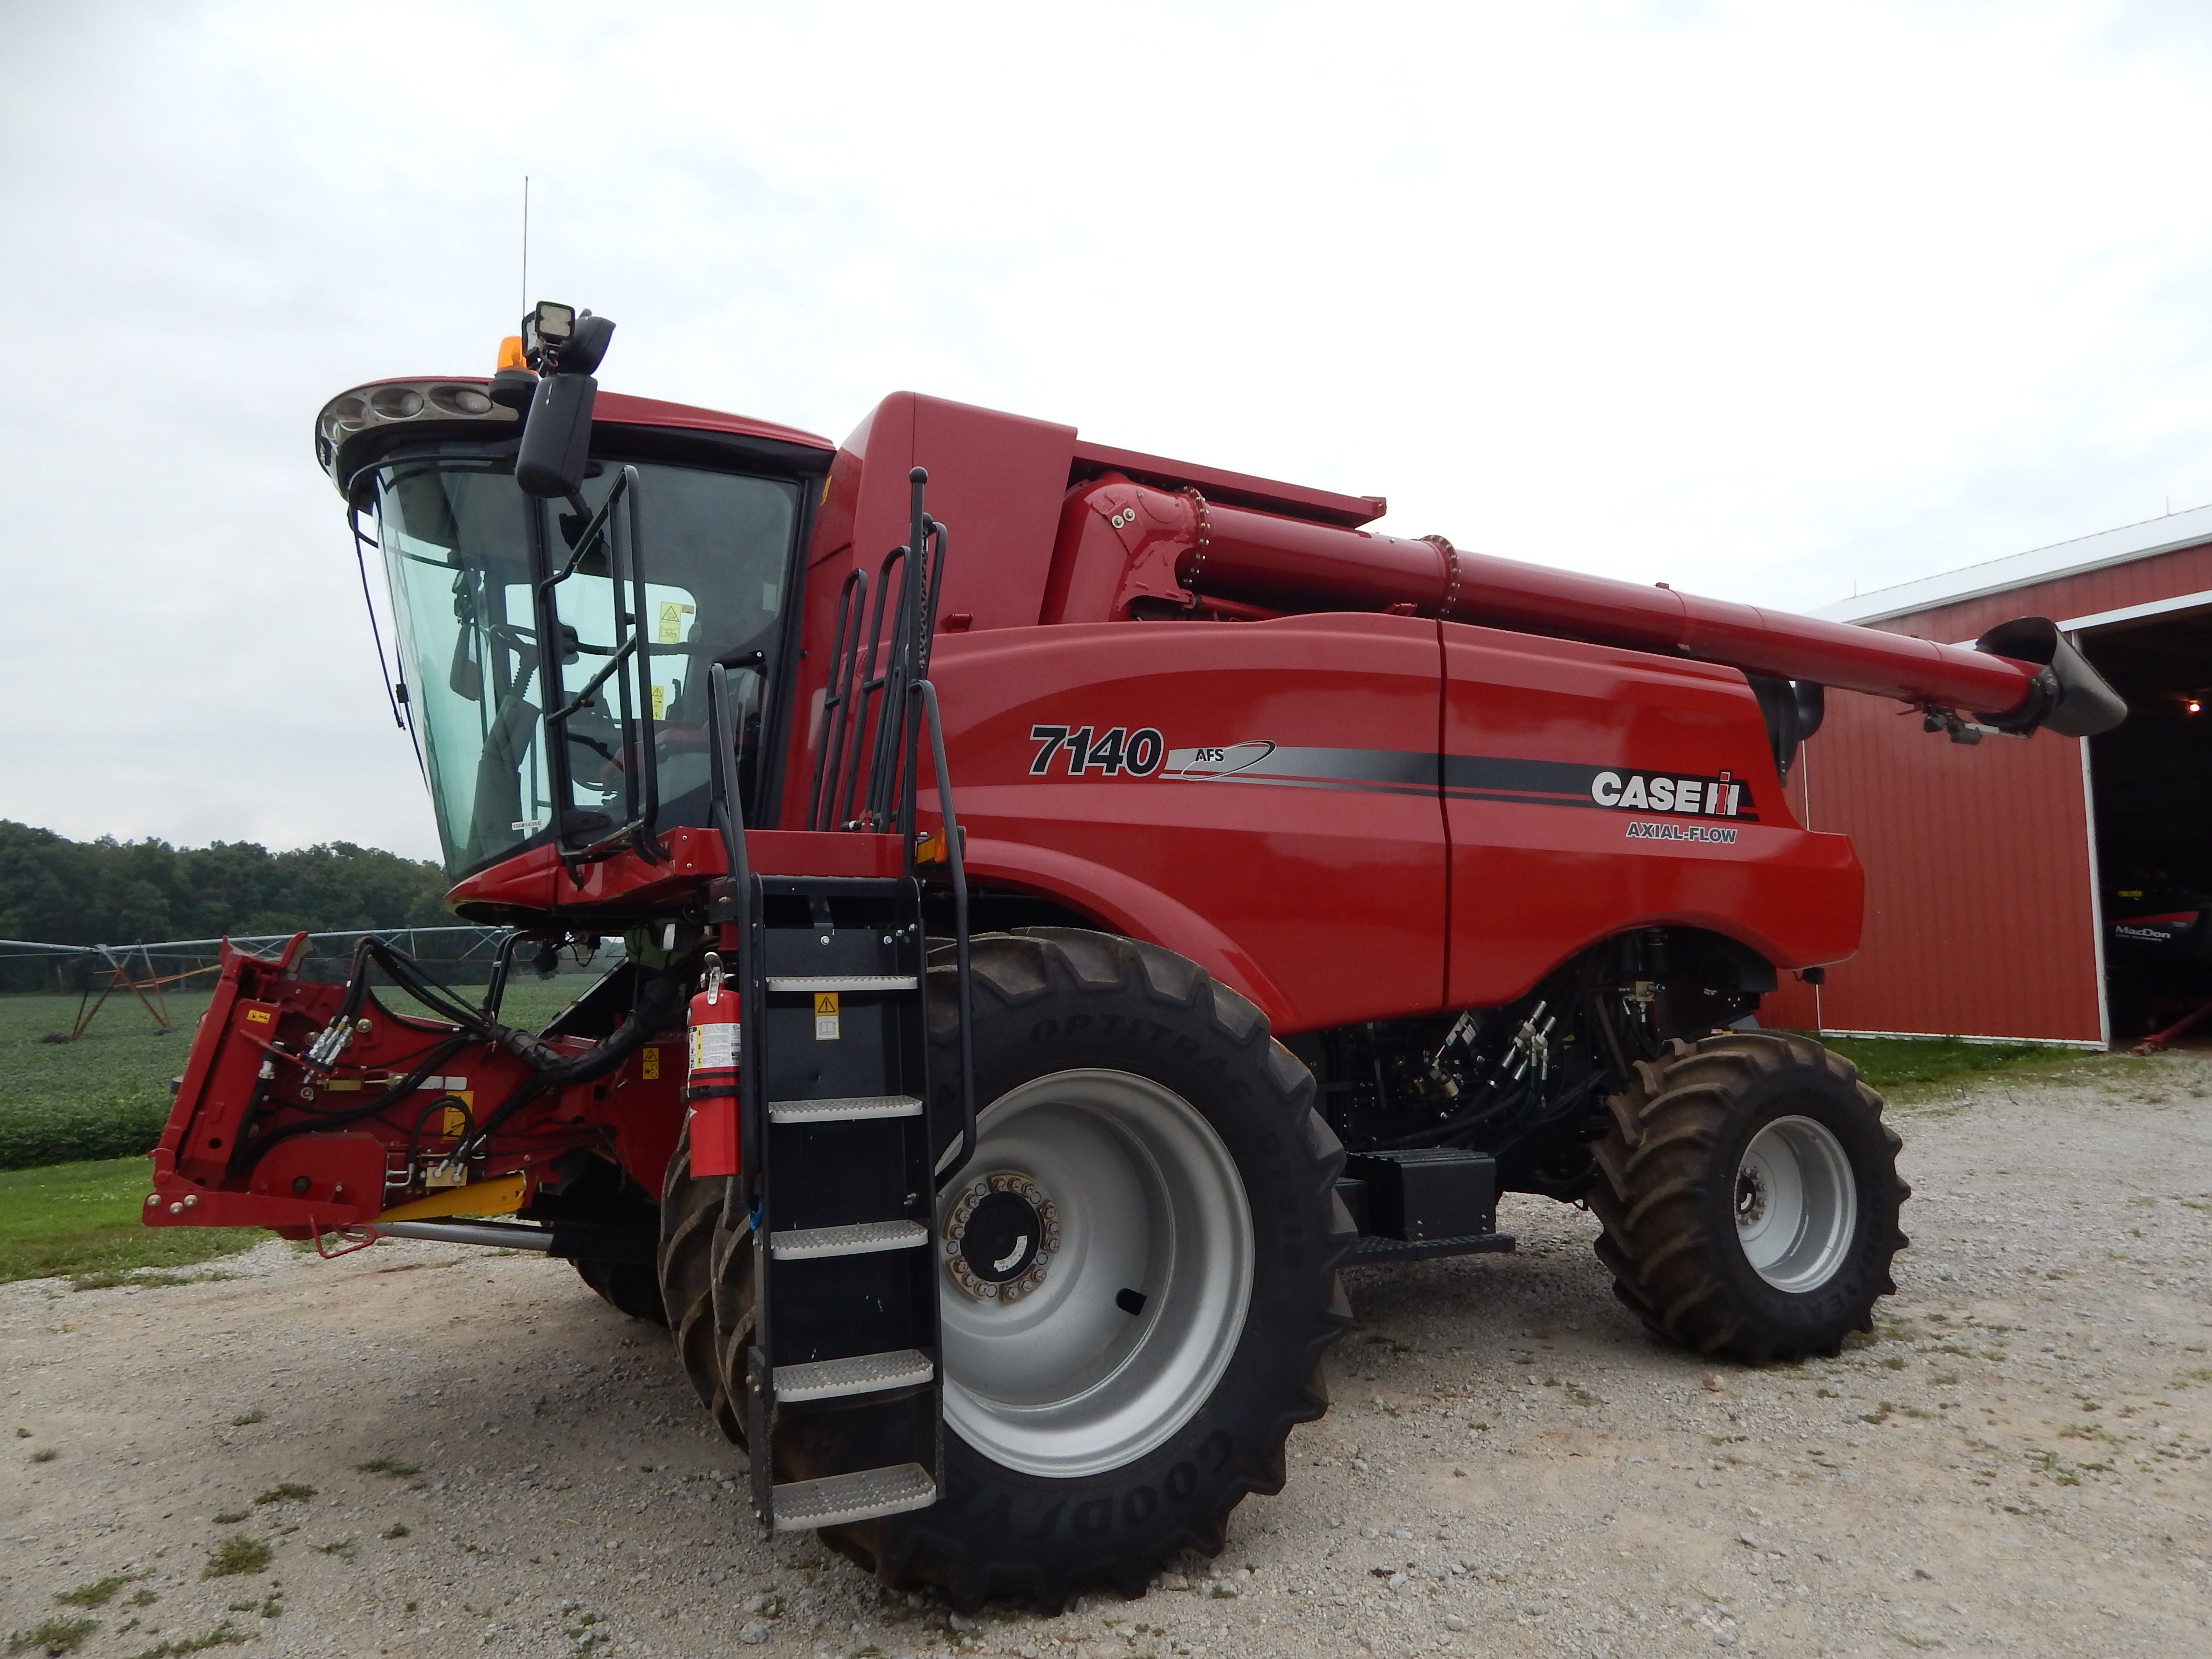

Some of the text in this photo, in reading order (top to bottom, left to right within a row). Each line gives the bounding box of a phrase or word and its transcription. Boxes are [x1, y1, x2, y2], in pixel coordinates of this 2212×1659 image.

[1029, 724, 1224, 778] 7140 AFS
[1591, 771, 1702, 813] CASE
[1625, 821, 1738, 844] AXIAL-FLOW
[2115, 925, 2171, 939] MacDon
[1030, 1014, 1253, 1103] OPTITRAC
